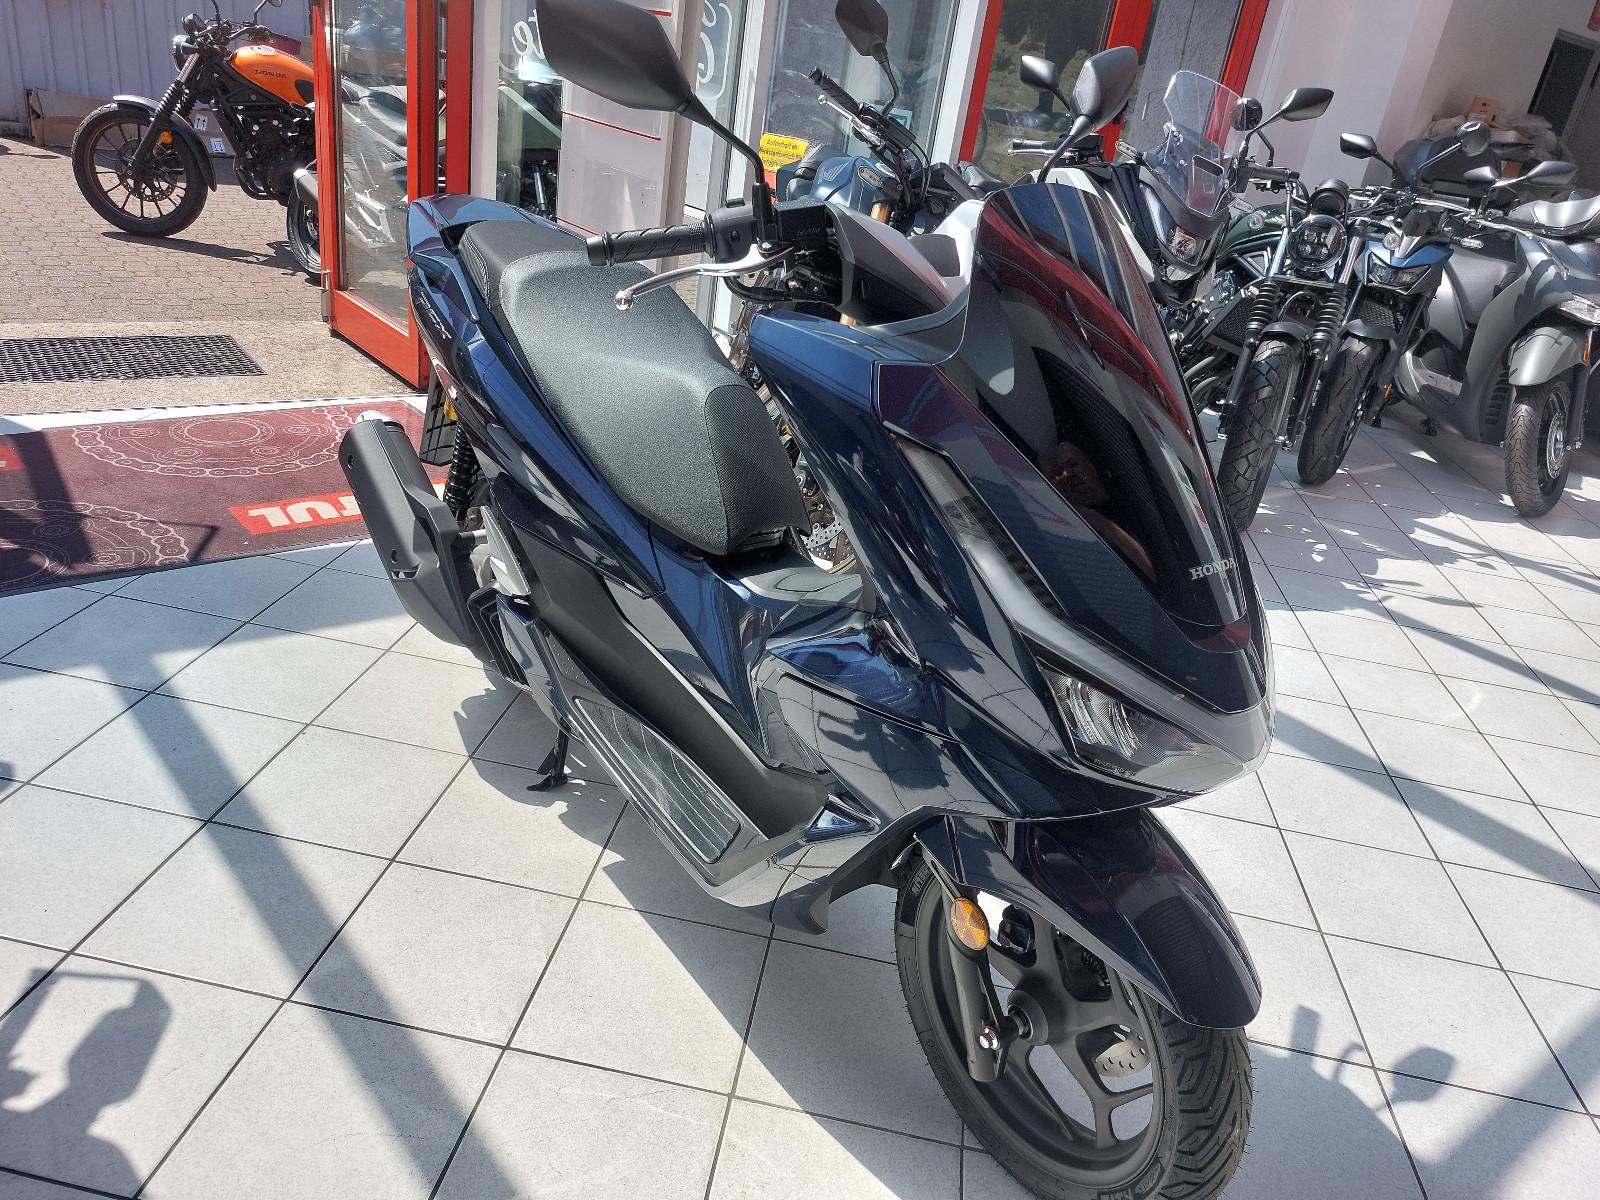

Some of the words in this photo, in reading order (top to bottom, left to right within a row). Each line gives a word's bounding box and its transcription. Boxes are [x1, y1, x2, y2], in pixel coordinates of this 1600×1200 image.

[254, 69, 287, 79] HONDA
[248, 495, 362, 527] TUL
[1188, 557, 1237, 581] HONDA
